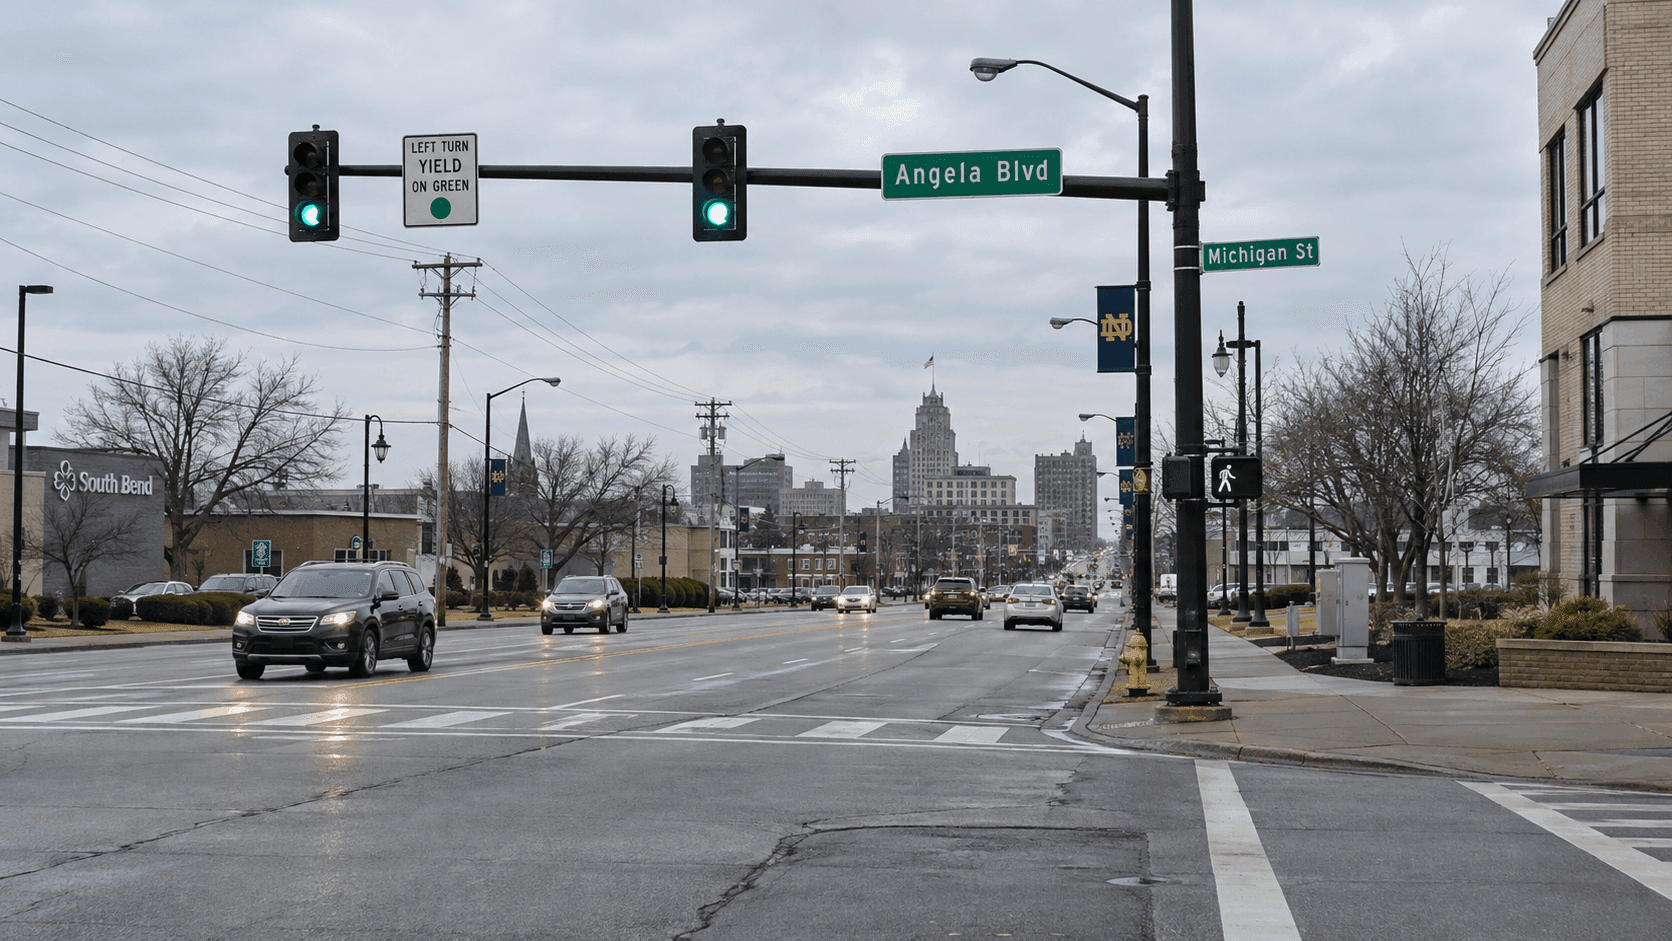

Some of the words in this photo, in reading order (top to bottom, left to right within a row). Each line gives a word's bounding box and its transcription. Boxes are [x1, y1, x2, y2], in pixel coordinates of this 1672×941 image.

[411, 141, 436, 154] LEFT
[441, 140, 469, 152] TURN
[419, 158, 462, 174] YIELD
[895, 162, 981, 189] Angela
[997, 159, 1048, 182] Blvd
[412, 181, 427, 193] ON
[433, 179, 469, 192] GREEN
[1208, 245, 1287, 266] Michigan
[1296, 243, 1313, 260] St
[79, 471, 118, 493] South
[120, 474, 153, 496] Bend
